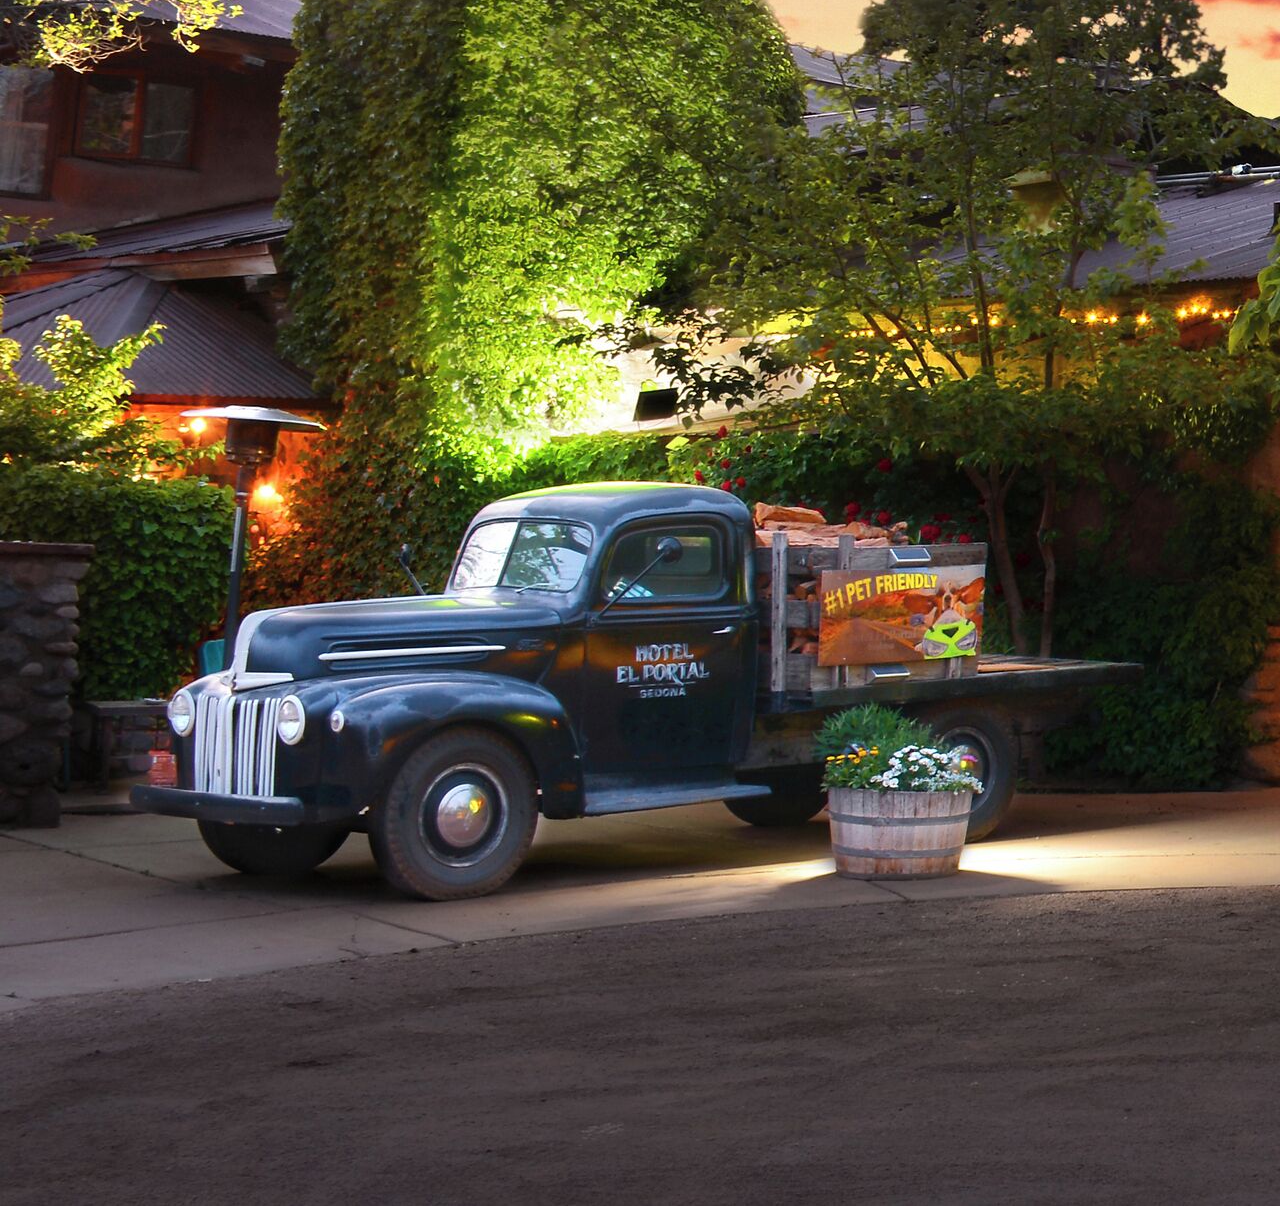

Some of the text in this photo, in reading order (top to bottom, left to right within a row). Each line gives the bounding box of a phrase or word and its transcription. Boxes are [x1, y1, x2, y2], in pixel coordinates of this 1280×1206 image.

[824, 573, 938, 616] #1 PET FRIENDLY
[635, 643, 694, 662] HOTEL
[616, 660, 710, 686] EL PORTAL
[640, 687, 687, 699] SEDONA
